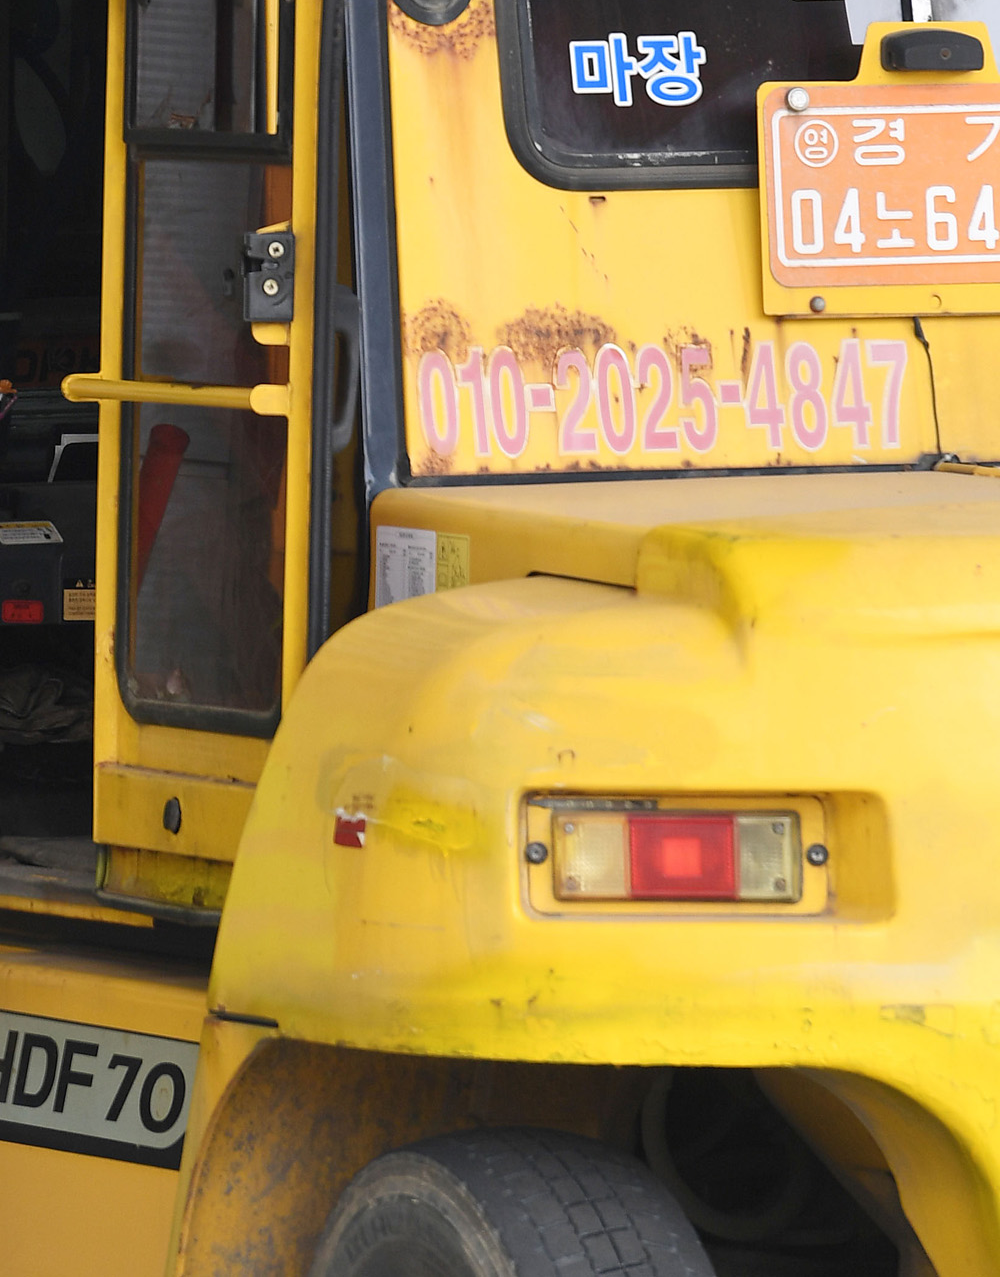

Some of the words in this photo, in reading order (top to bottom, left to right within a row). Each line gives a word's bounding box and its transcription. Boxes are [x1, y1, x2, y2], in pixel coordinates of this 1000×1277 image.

[569, 31, 707, 107] 마장
[791, 184, 1000, 254] 04노64
[418, 341, 909, 458] 010-2025-4847
